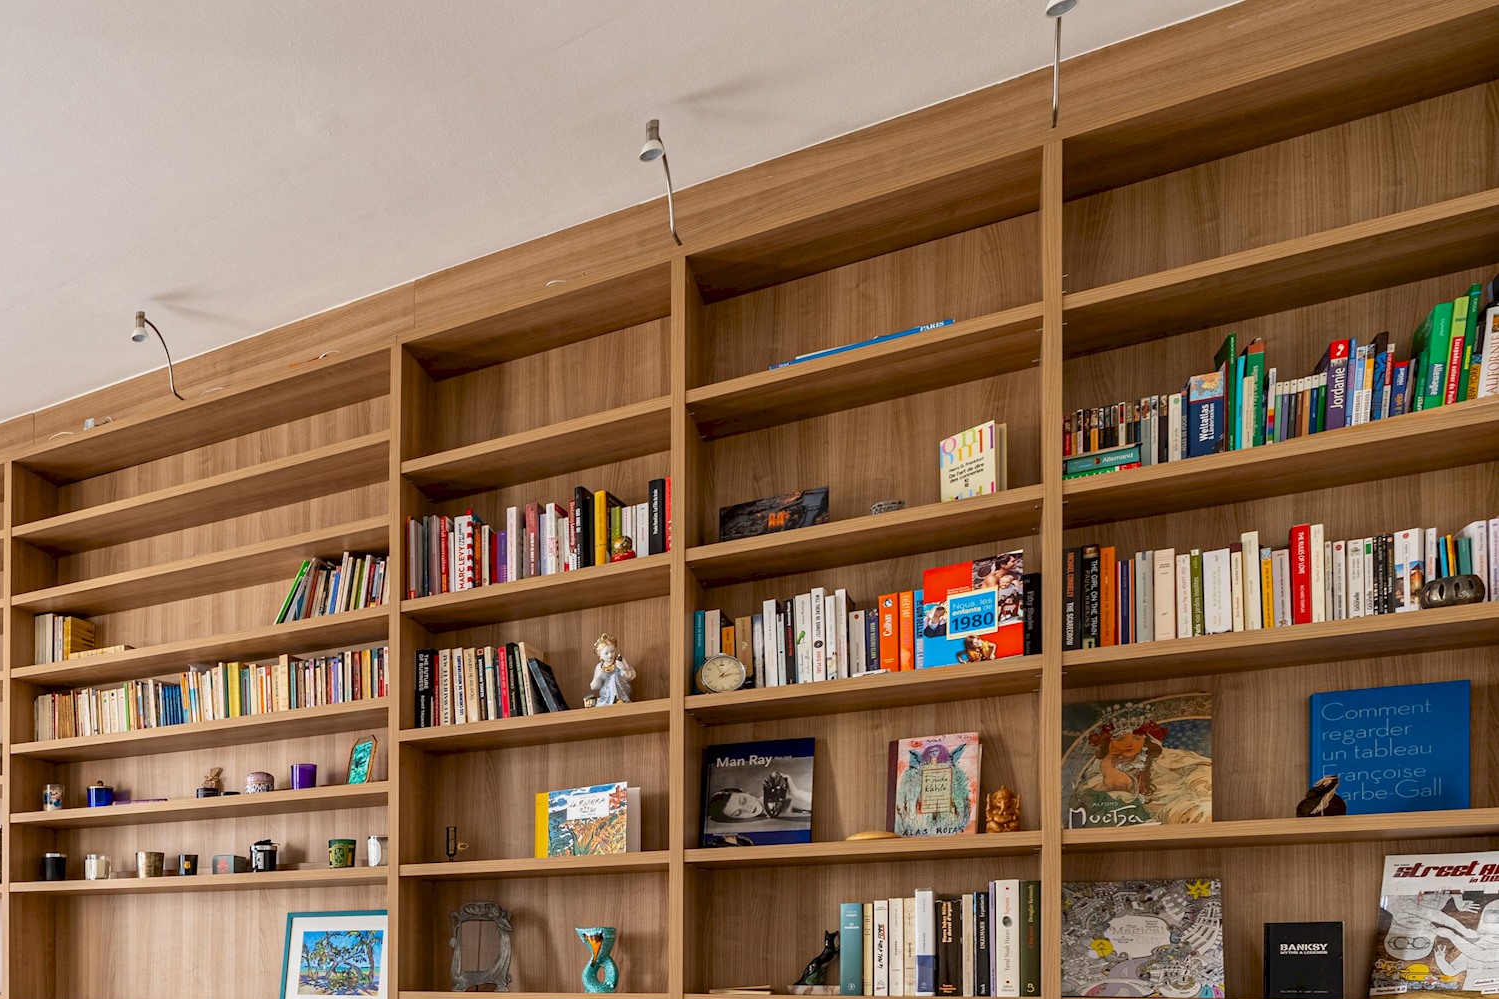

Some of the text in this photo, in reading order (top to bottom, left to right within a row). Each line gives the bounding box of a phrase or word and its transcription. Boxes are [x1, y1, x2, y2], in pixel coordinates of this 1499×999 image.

[1451, 338, 1462, 364] Escapades
[1430, 364, 1443, 395] Allemagne
[1469, 366, 1479, 384] YORK
[1330, 367, 1345, 409] Jordanie
[1199, 404, 1209, 441] Weltatlas
[1102, 452, 1133, 463] Allemand
[1299, 554, 1305, 562] OF
[1026, 591, 1034, 606] Fifty
[1091, 592, 1097, 601] ON
[1194, 598, 1202, 614] jardins
[952, 607, 981, 616] enfants
[952, 612, 994, 630] 1980
[883, 613, 892, 637] CASPARY
[1066, 613, 1074, 646] SCARECROW
[1321, 700, 1431, 721] Comment
[1322, 718, 1412, 745] regarder
[1323, 738, 1431, 761] un tableau
[717, 757, 745, 767] Man
[749, 755, 772, 767] Ray
[1323, 764, 1426, 784] Françoise
[1335, 777, 1442, 801] arbe-Gall
[1393, 861, 1480, 877] street
[1110, 927, 1165, 936] Magical
